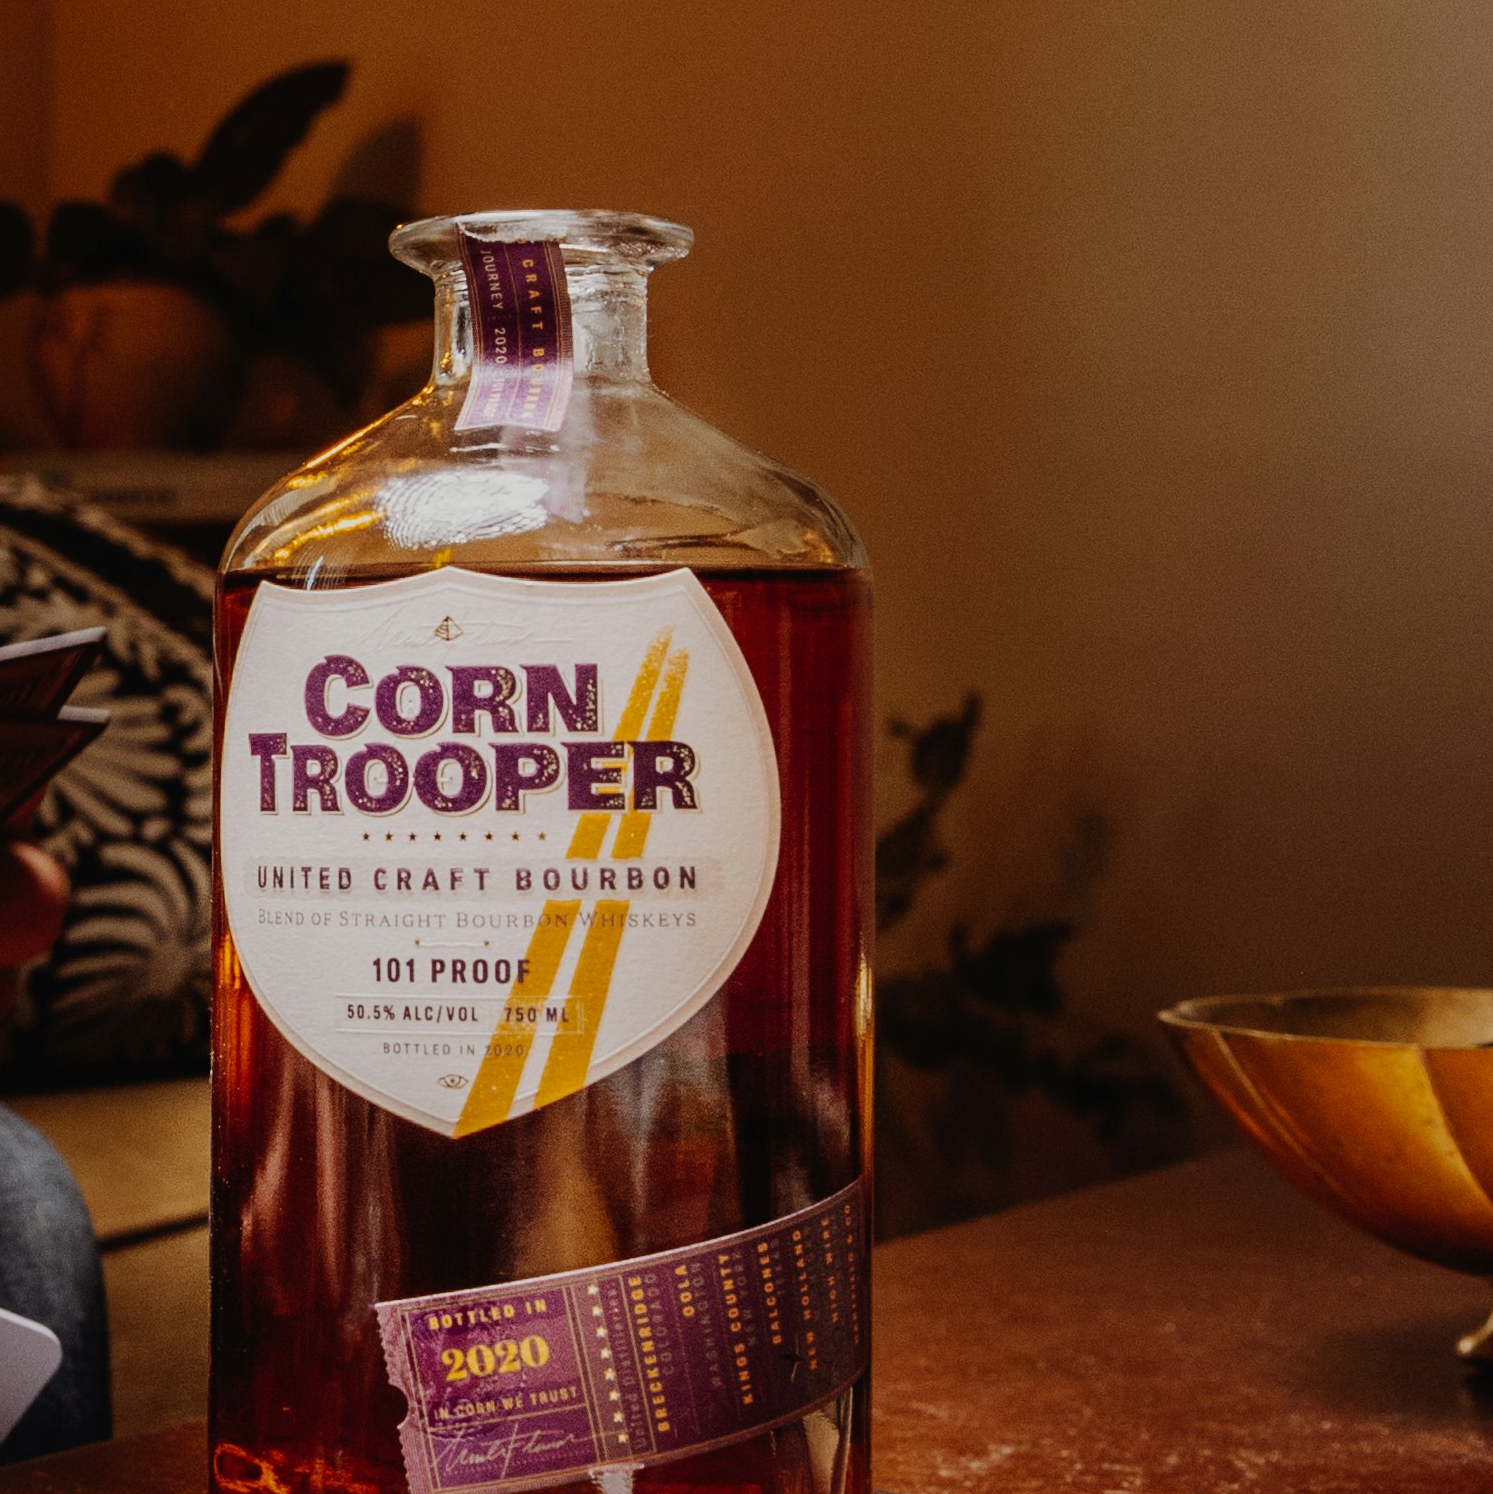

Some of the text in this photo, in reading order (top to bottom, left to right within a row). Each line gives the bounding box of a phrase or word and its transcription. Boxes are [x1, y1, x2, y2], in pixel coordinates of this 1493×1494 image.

[480, 250, 504, 310] JOURNEY
[494, 327, 507, 364] 2020
[522, 259, 544, 330] CRAFT
[304, 655, 600, 738] CORN
[248, 733, 698, 813] TROOPER
[258, 865, 696, 891] UNITED CRAFT BOURBON
[258, 908, 697, 929] BLEND OF STRAIGHT BOURBON WHISKEYS
[372, 957, 531, 985] 101 PROOF
[347, 1004, 569, 1023] 50.5% ALC/VOL 750 ML
[383, 1041, 525, 1057] BOTTLED IN 2020
[674, 1264, 696, 1317] OOLA
[757, 1242, 782, 1345] BALCONES
[792, 1229, 812, 1321] HOLLAND
[428, 1299, 548, 1331] BOTTLED IN
[644, 1274, 674, 1375] COLORADO
[718, 1254, 754, 1405] KINGS COUNTY
[441, 1335, 551, 1382] 2020
[628, 1276, 670, 1432] BRECKENRIDGE
[434, 1386, 578, 1420] IN CORN WE TRUST
